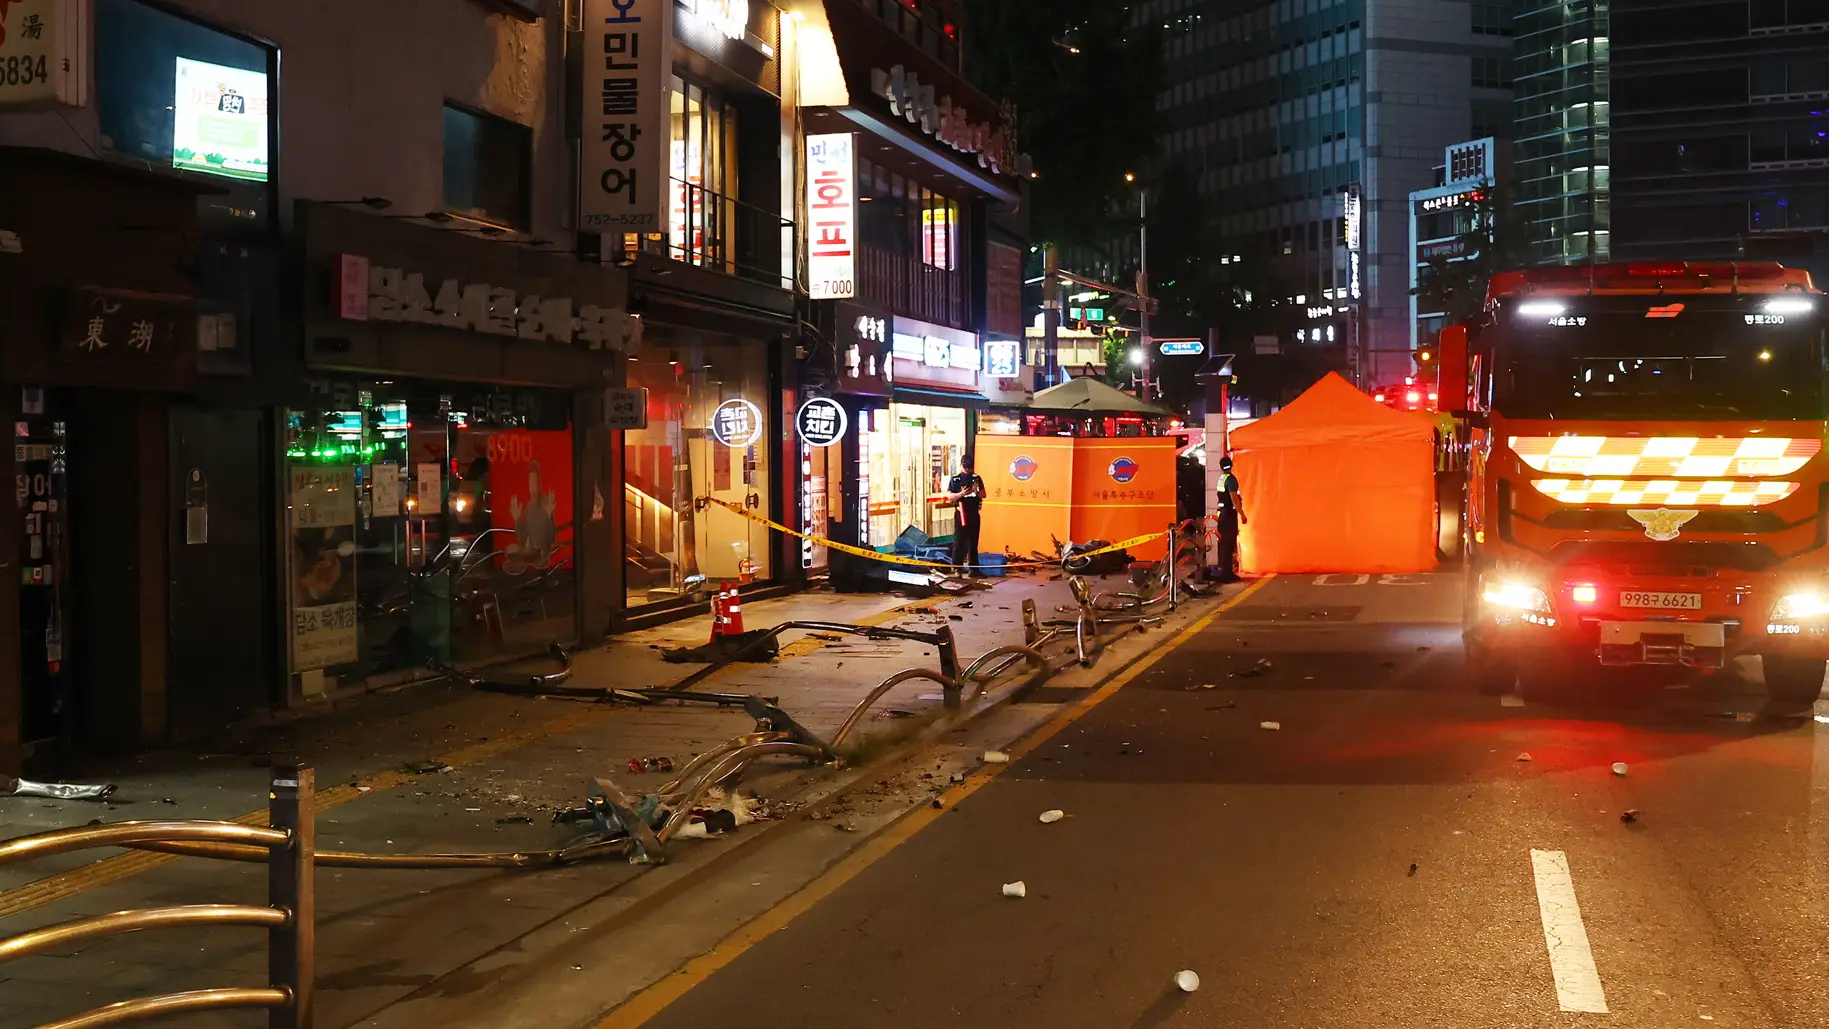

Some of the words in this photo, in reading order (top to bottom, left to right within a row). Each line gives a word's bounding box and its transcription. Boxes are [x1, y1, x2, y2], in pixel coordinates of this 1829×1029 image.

[20, 14, 44, 40] 湯
[601, 33, 642, 205] 민물장어
[586, 213, 654, 226] 752-5237
[811, 170, 851, 257] 호프
[1547, 316, 1587, 327] 서울소방
[991, 360, 1013, 374] 25
[806, 405, 836, 420] 교촌
[805, 419, 834, 434] 치킨
[1092, 489, 1155, 501] 서울특수구조단
[1625, 592, 1659, 606] 998구
[1662, 594, 1696, 607] 6621
